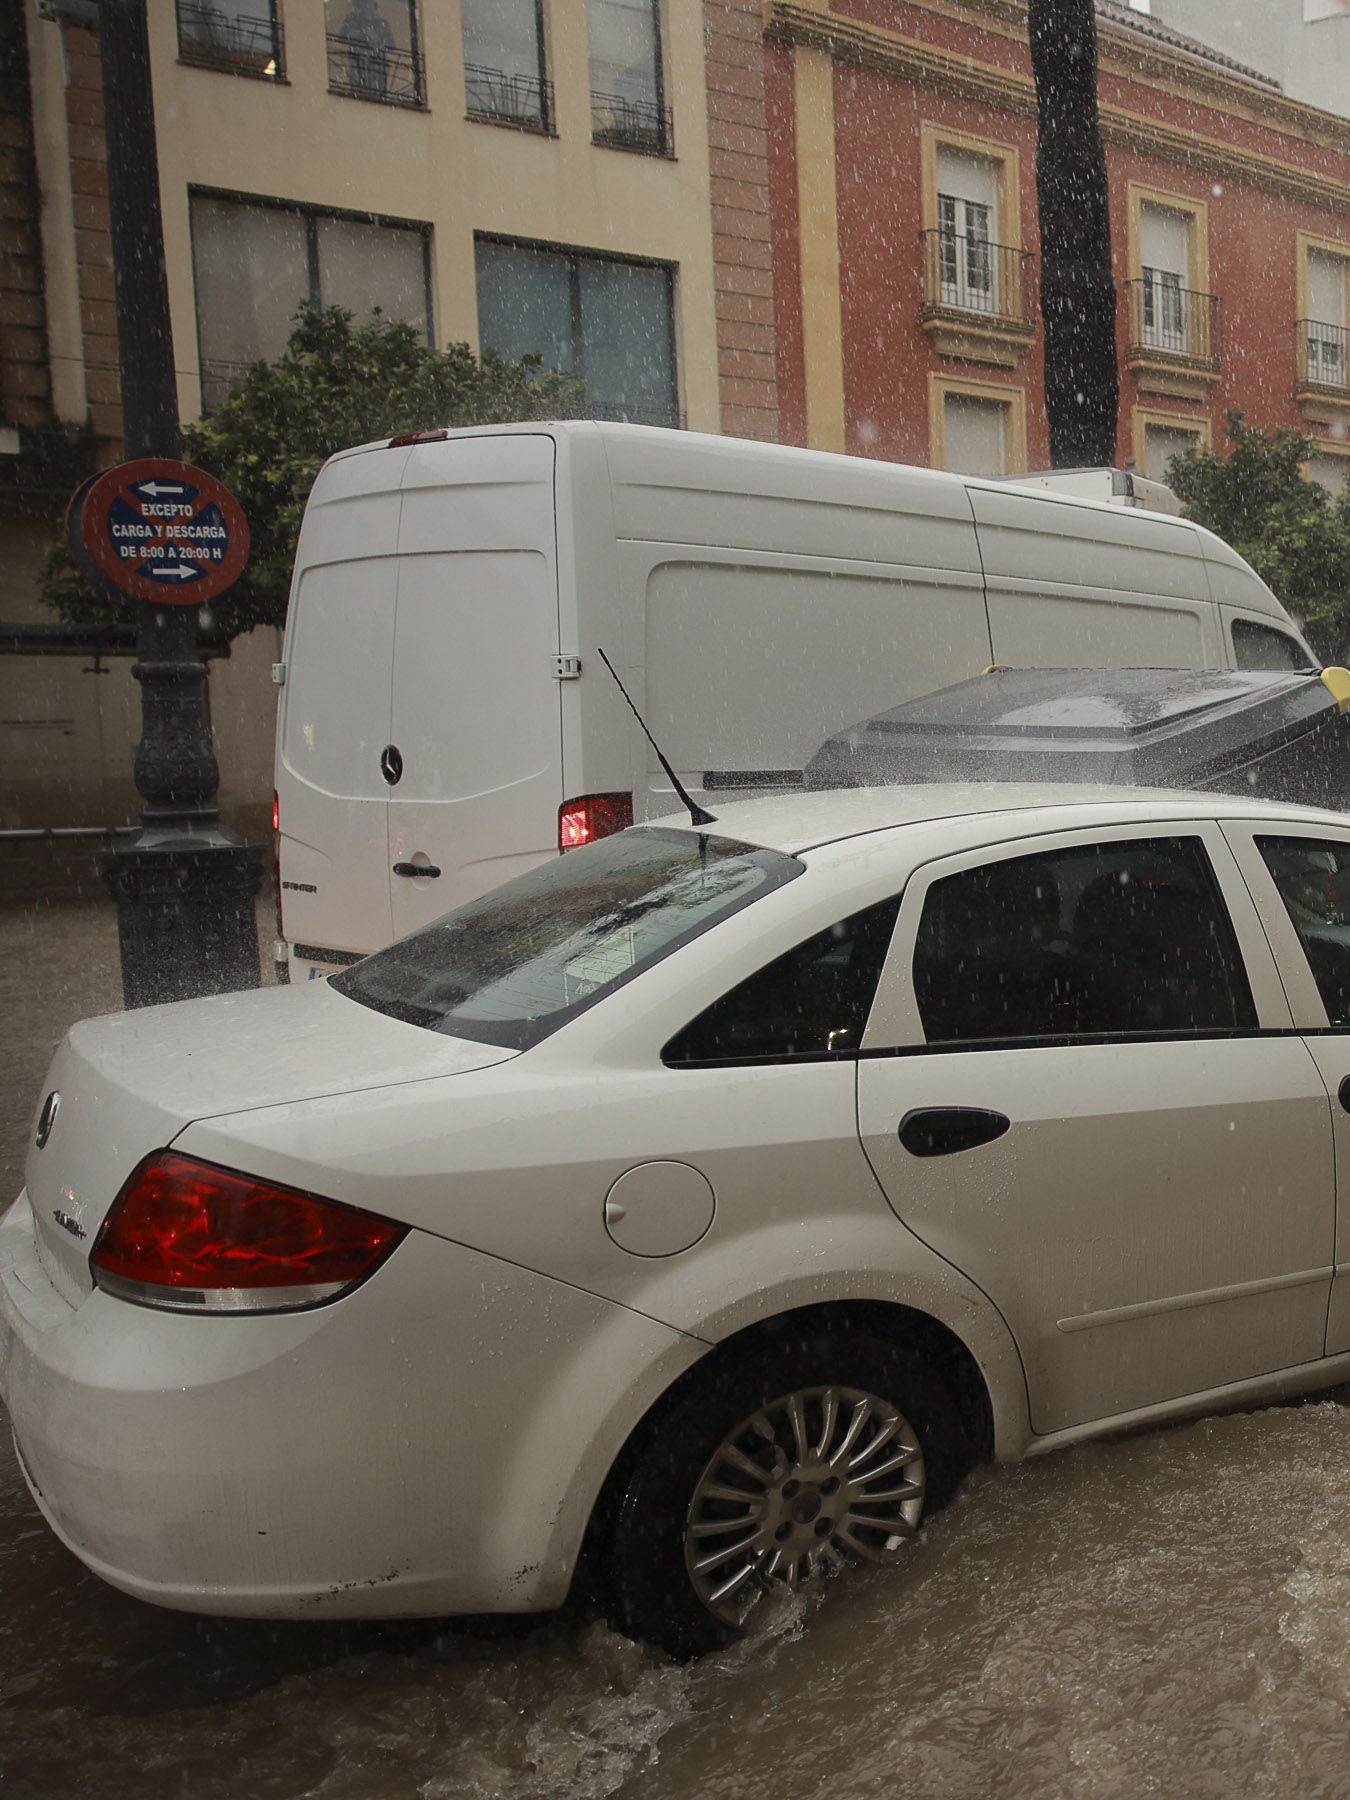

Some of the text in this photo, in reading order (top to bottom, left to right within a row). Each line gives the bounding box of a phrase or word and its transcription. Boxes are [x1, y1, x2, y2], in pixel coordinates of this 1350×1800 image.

[141, 503, 193, 517] EXCEPTO
[112, 524, 226, 538] CARGA Y DESCARGA
[120, 546, 222, 559] DE 8:00 A 20:00 H
